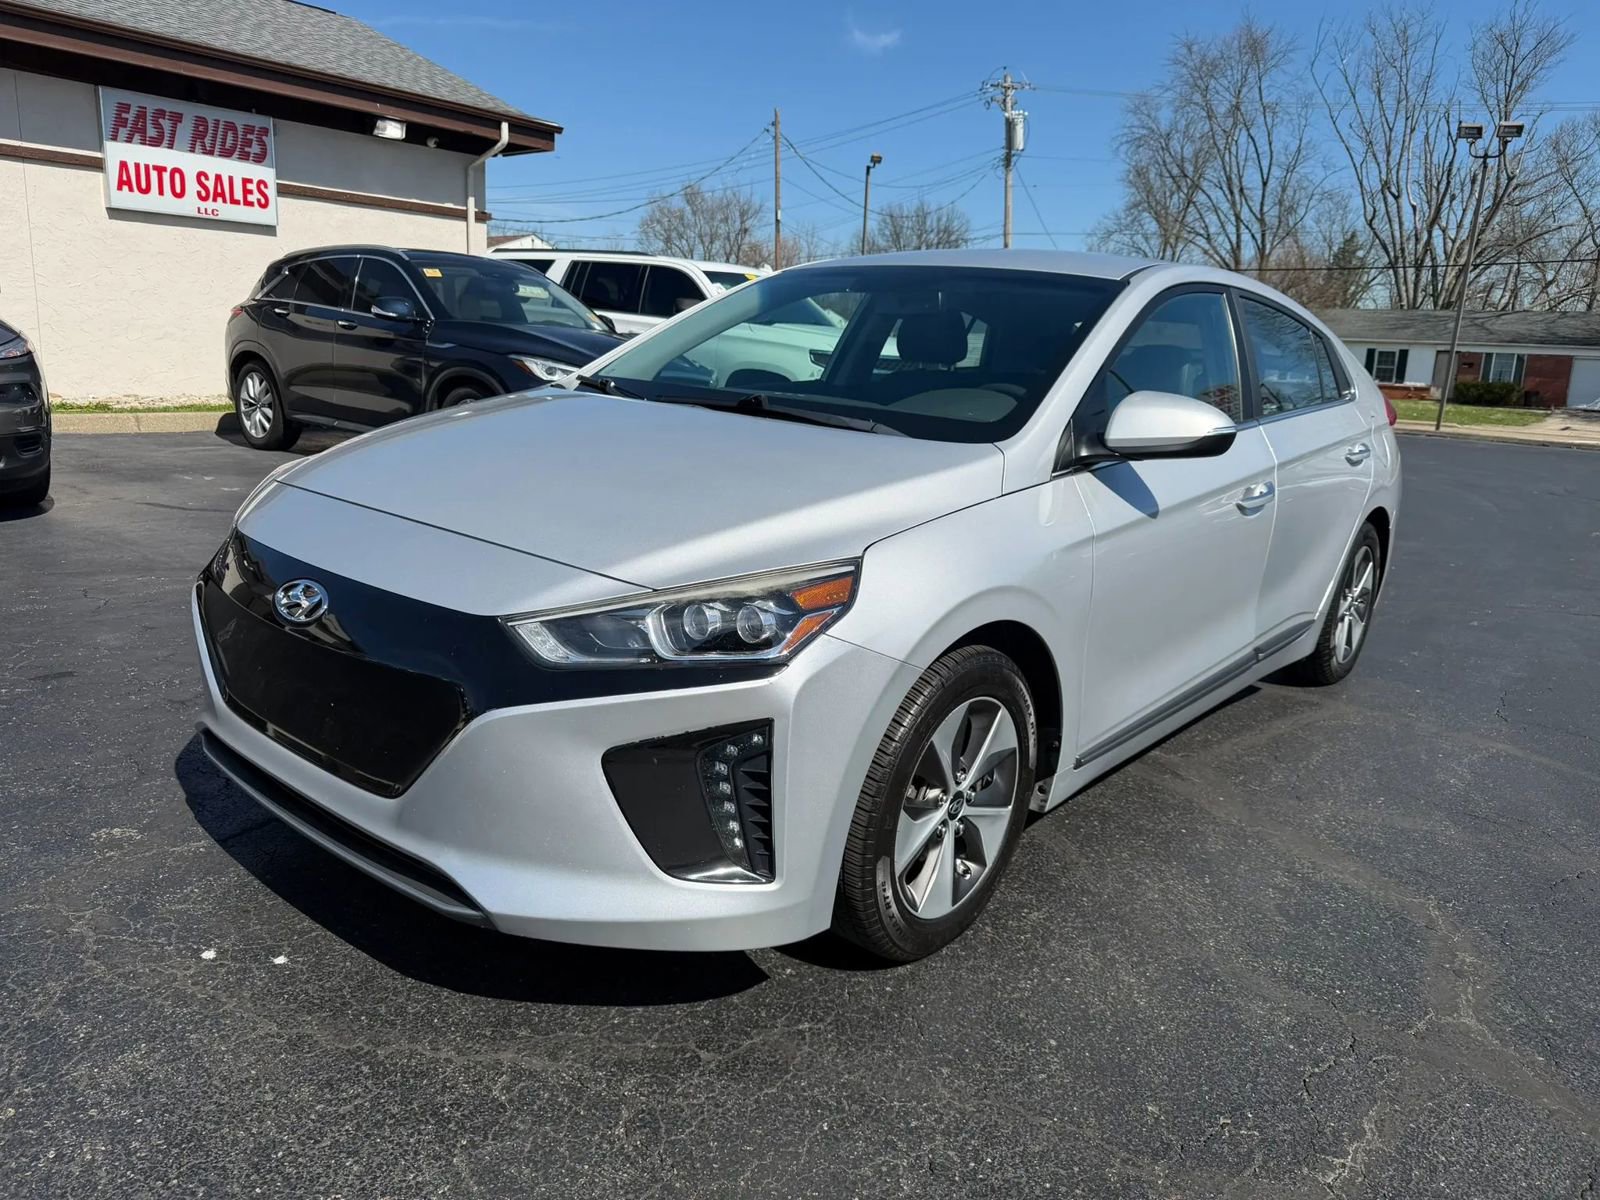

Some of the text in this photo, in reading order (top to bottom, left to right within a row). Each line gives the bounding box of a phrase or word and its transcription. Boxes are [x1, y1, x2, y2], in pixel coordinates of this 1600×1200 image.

[110, 102, 269, 163] FAST RIDES
[117, 160, 270, 209] AUTO SALES
[197, 206, 219, 217] LLC
